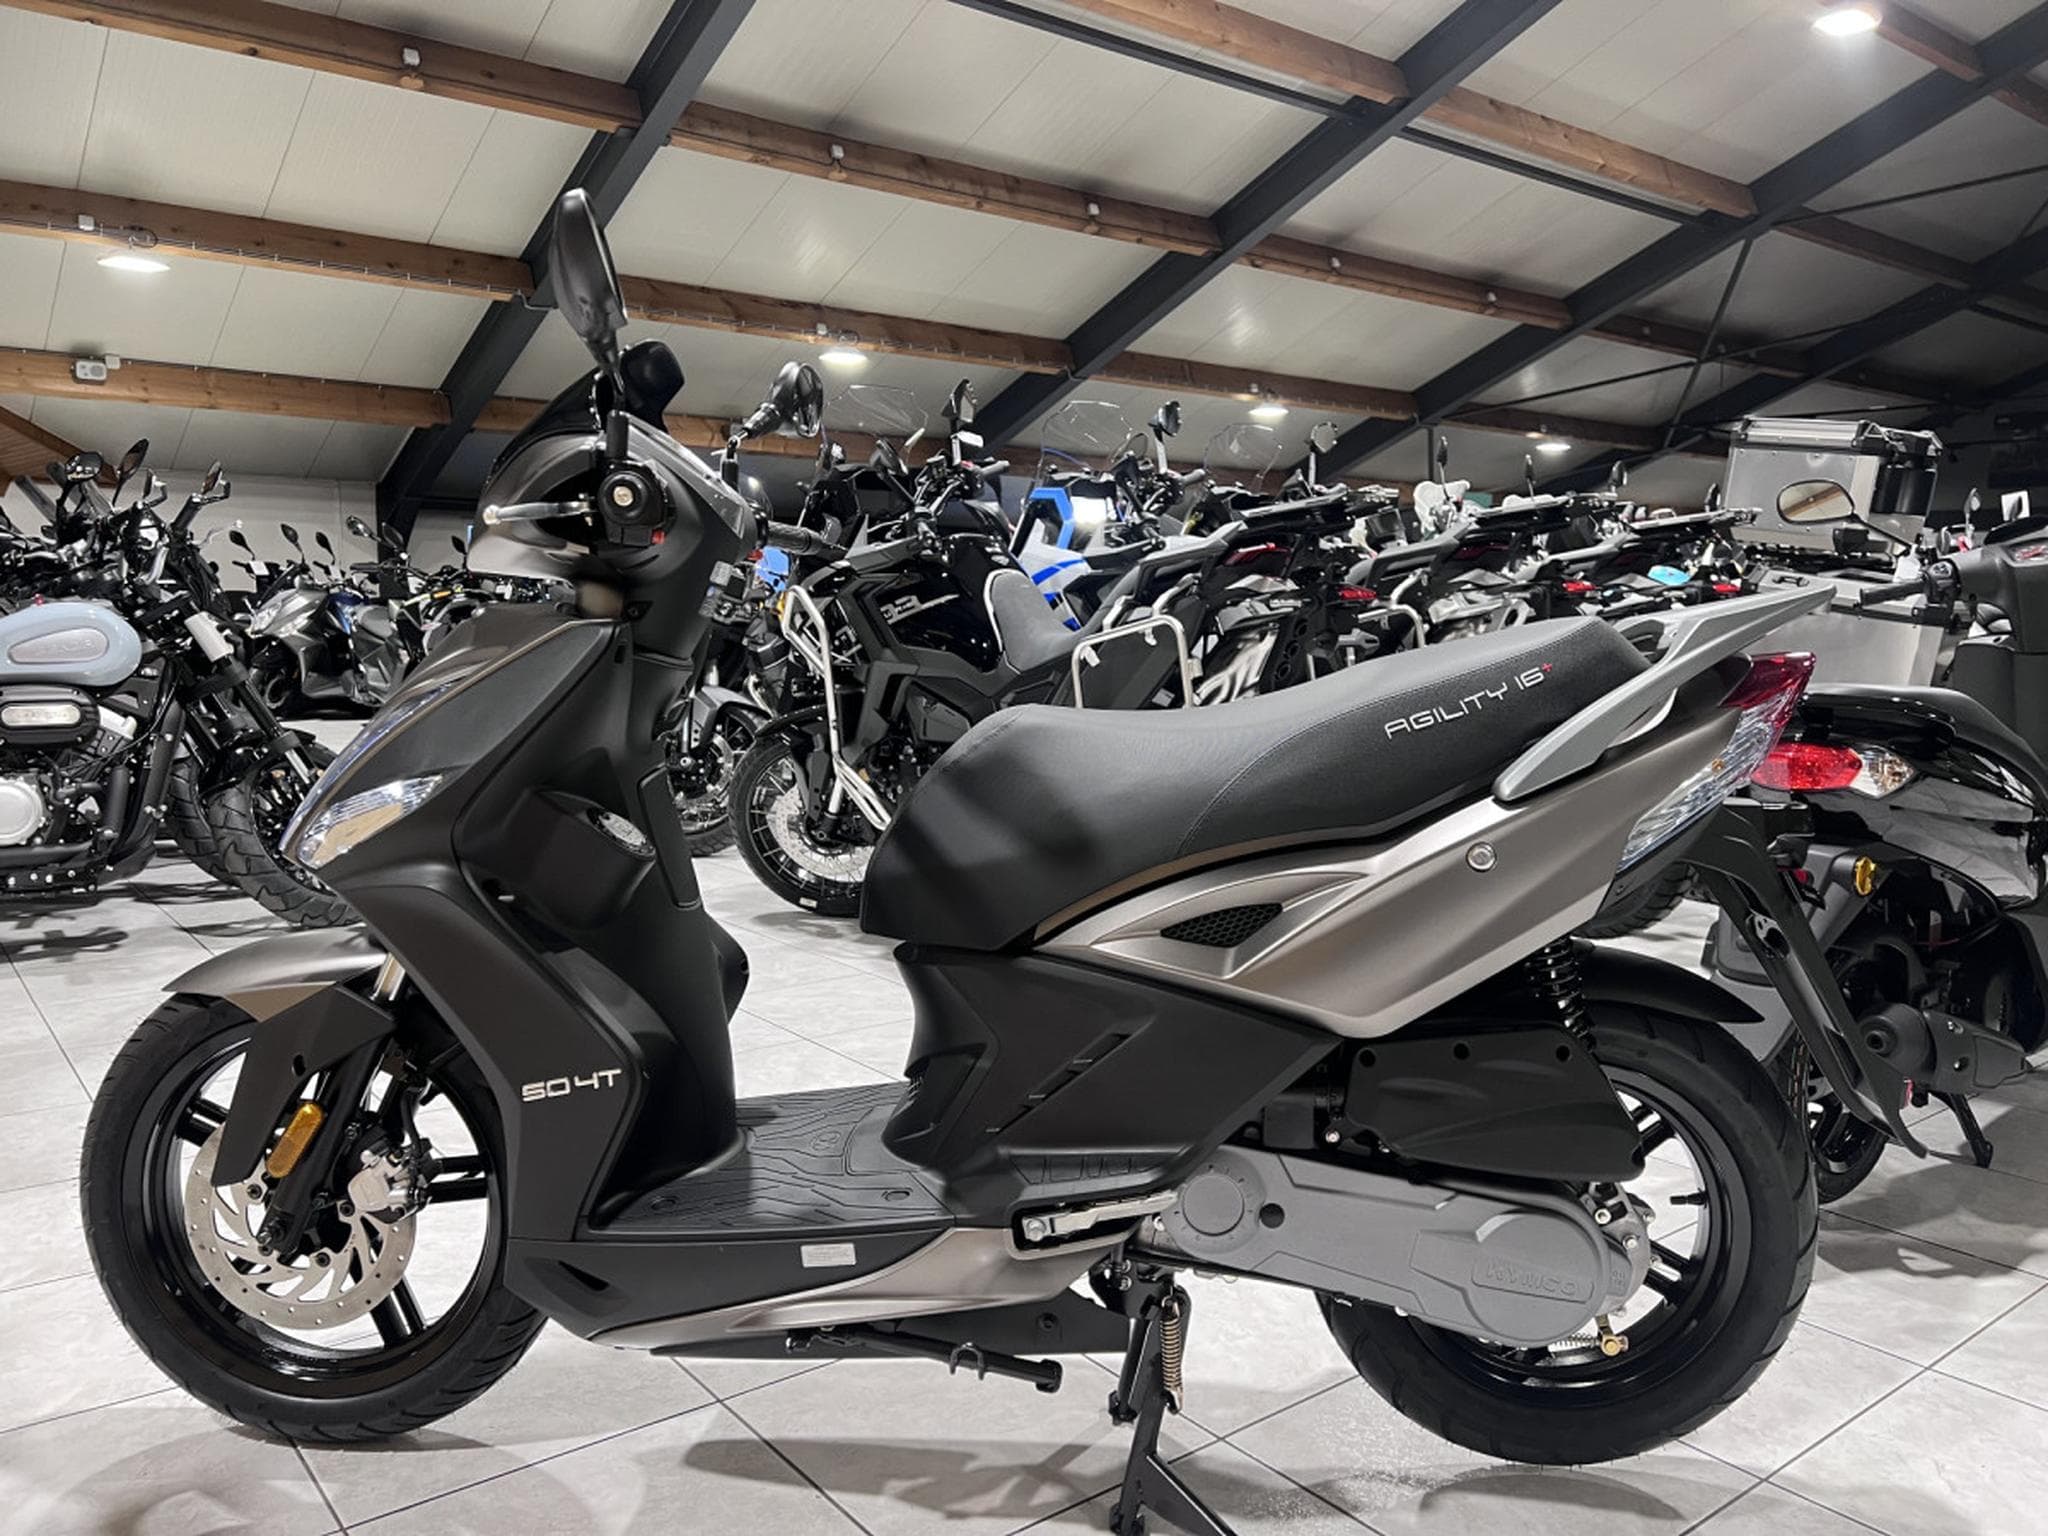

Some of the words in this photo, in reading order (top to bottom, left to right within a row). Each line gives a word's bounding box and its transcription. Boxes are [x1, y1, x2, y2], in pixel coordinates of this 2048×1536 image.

[1384, 682, 1509, 740] AGILITY
[521, 1076, 572, 1102] 50
[573, 1068, 622, 1090] 4T
